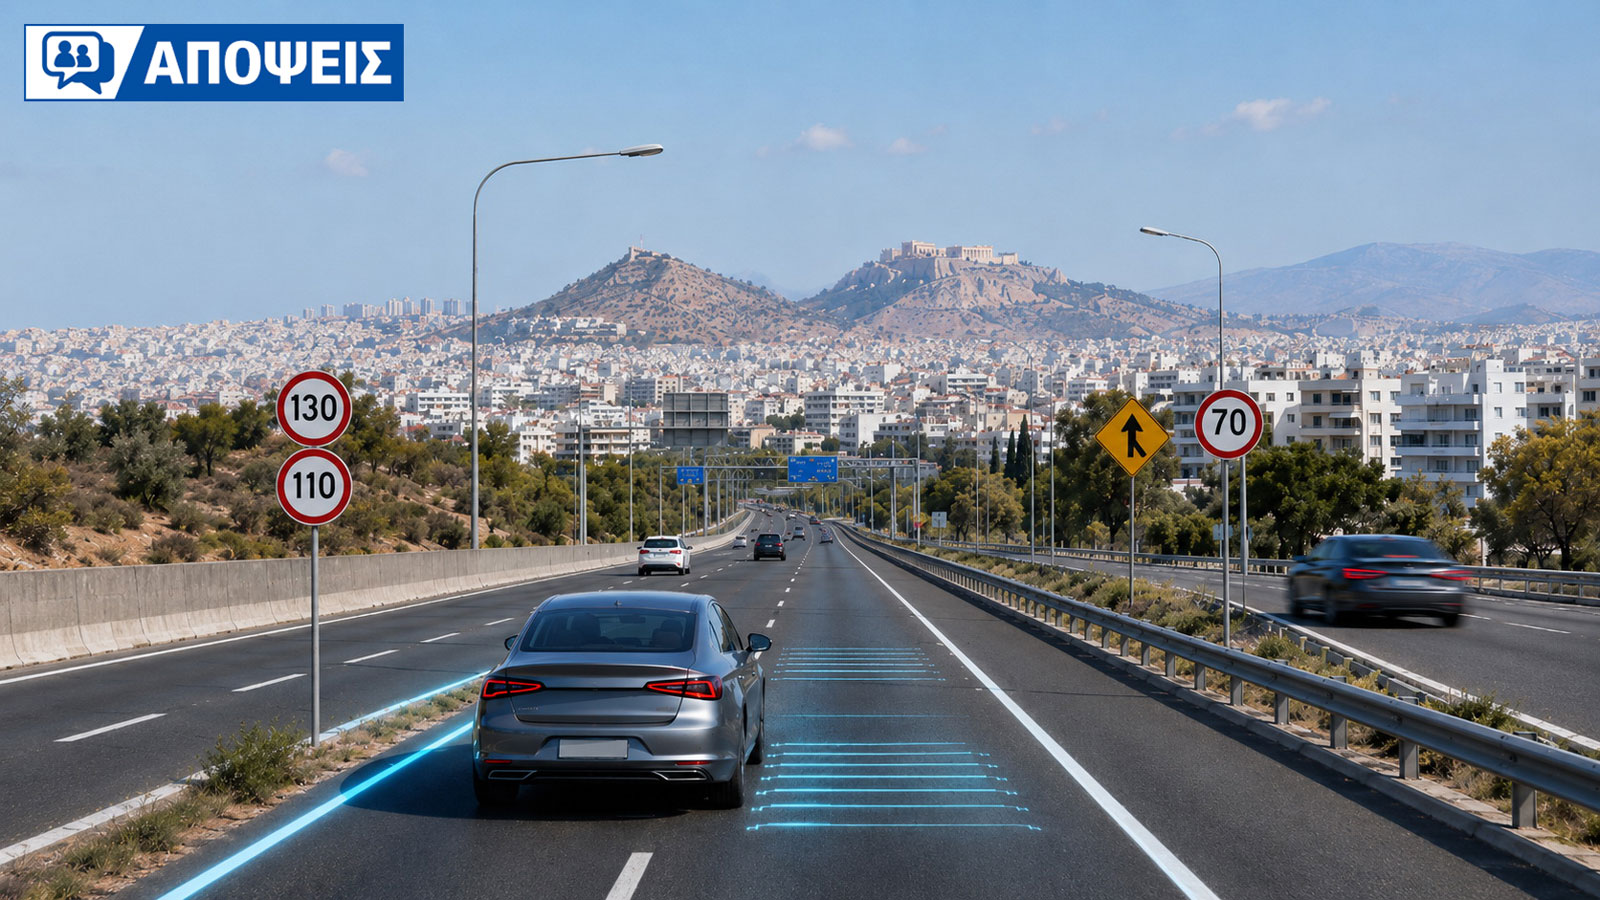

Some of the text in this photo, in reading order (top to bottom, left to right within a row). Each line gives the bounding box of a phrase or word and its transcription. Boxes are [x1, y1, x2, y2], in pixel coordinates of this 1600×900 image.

[291, 394, 337, 421] 130
[1212, 408, 1247, 436] 70
[293, 471, 335, 499] 110
